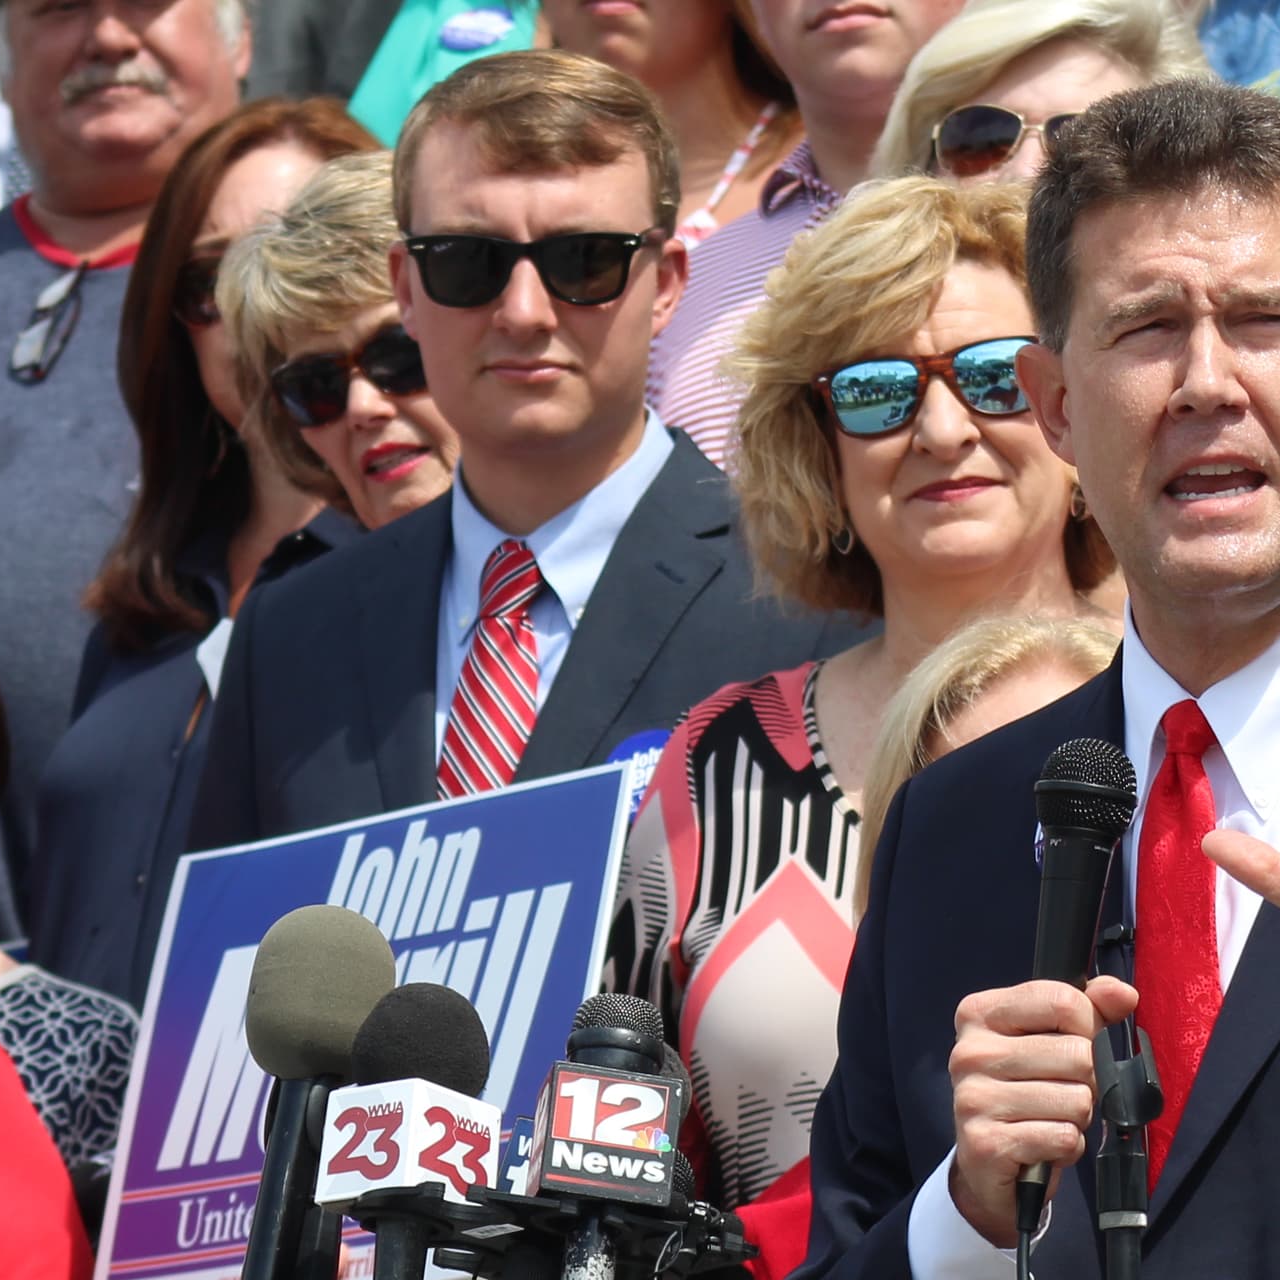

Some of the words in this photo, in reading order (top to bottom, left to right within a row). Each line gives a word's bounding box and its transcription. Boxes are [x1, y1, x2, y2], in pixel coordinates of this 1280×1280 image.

[367, 1101, 404, 1117] WVUA
[456, 1115, 491, 1138] WVUA
[560, 1078, 665, 1146] 12
[327, 1106, 404, 1180] 23
[418, 1106, 491, 1197] 23
[551, 1141, 665, 1184] News
[177, 1192, 255, 1249] Unite
